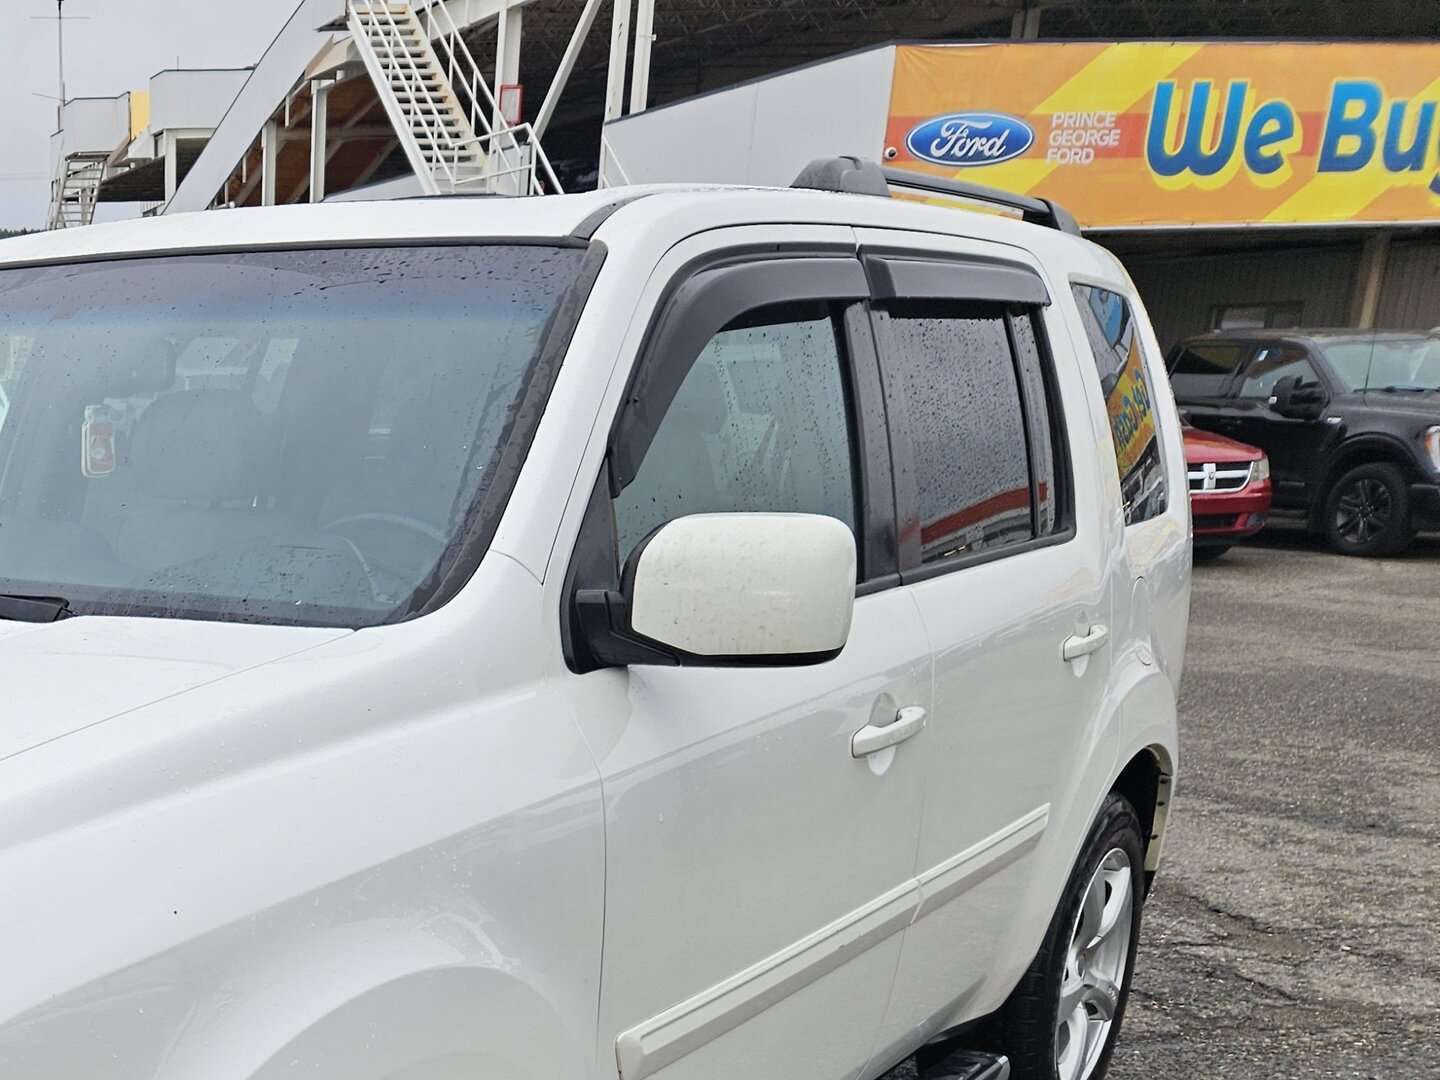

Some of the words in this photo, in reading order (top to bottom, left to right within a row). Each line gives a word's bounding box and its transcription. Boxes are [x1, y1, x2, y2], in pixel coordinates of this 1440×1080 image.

[1052, 112, 1116, 128] PRINCE
[930, 119, 1010, 158] Ford
[1049, 129, 1120, 146] GEORGE
[1146, 80, 1295, 176] We
[1317, 80, 1440, 196] Bu
[1045, 148, 1094, 165] FORD
